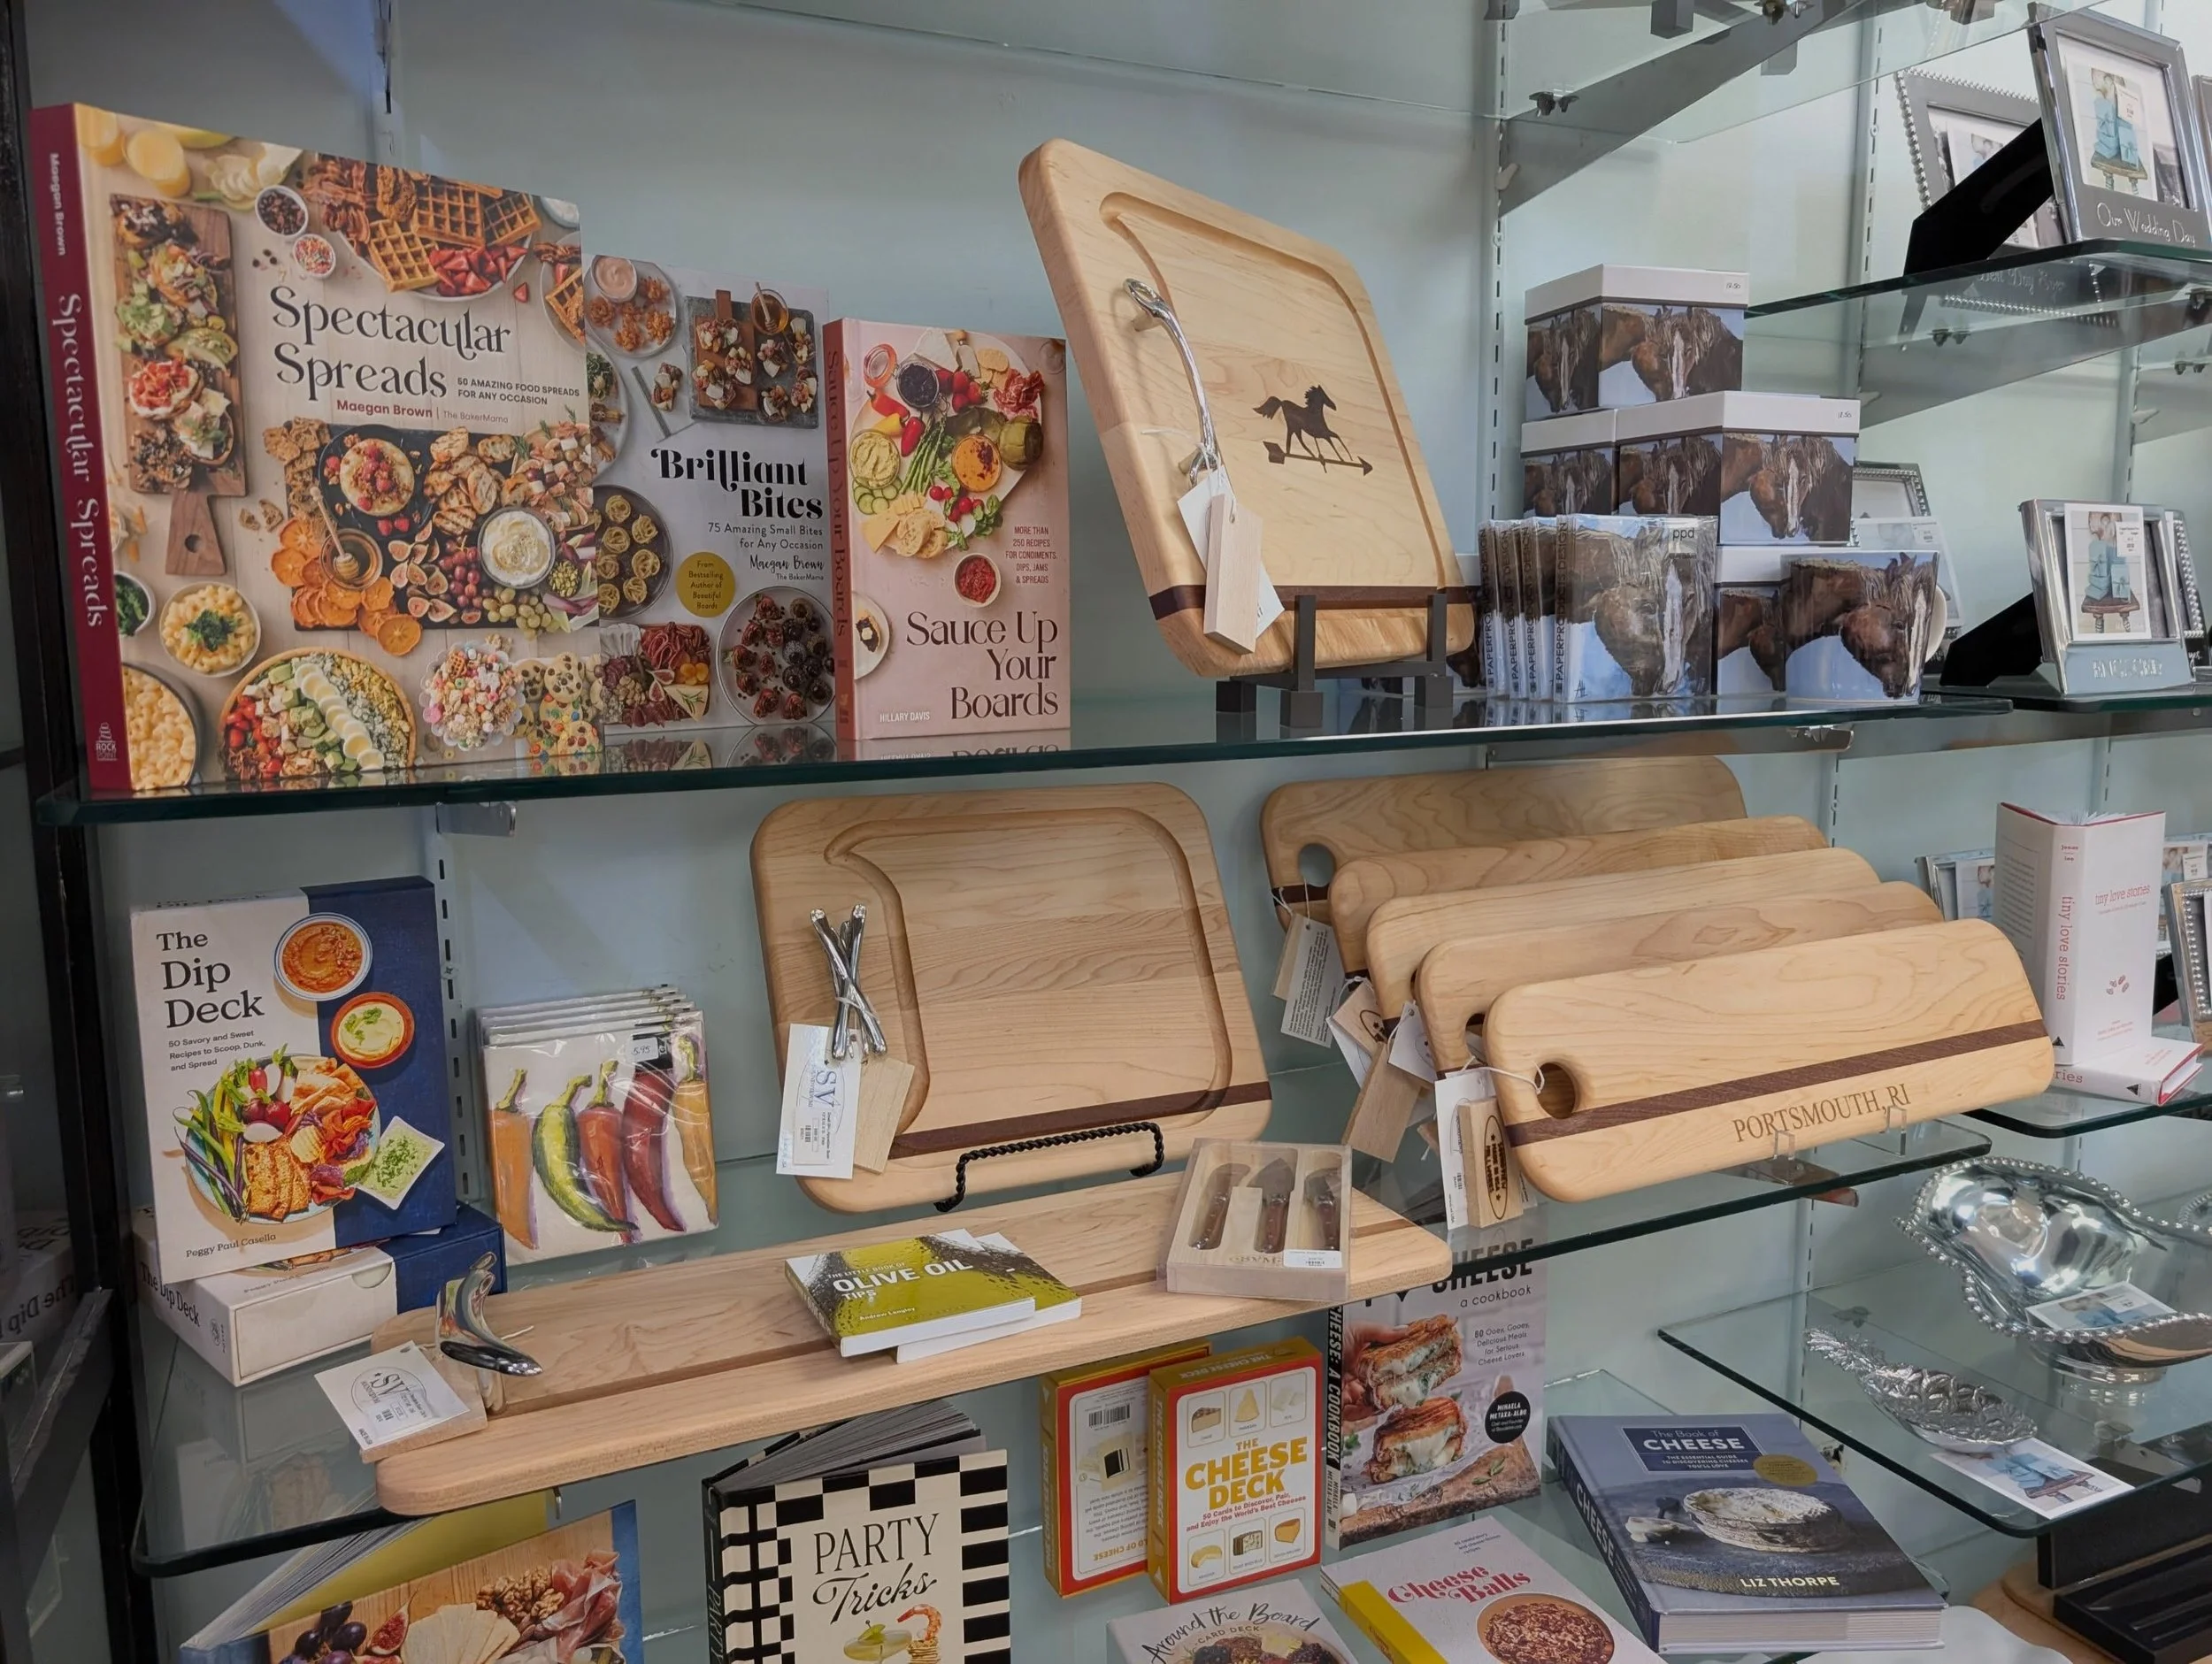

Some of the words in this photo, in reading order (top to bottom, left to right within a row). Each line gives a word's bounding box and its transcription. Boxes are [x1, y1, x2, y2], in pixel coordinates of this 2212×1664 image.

[54, 209, 65, 257] Brown
[2172, 219, 2196, 249] Day
[269, 286, 511, 361] Spectacular
[273, 341, 448, 402] Spreads
[457, 390, 476, 401] FOR
[479, 392, 497, 403] ANY
[499, 395, 549, 406] OCCASION
[472, 379, 513, 392] AMAZING
[516, 383, 541, 394] FOOD
[542, 386, 580, 397] SPREADS
[827, 350, 841, 431] Sauce
[336, 400, 389, 417] Maegan
[393, 404, 434, 419] Brown
[443, 410, 458, 421] The
[460, 411, 509, 424] BakerMama
[51, 292, 91, 482] Spectacular
[71, 497, 103, 628] Spreads
[650, 449, 808, 493] Brilliant
[740, 487, 824, 520] Bites
[708, 522, 721, 533] 75
[724, 523, 767, 538] Amazing
[770, 524, 796, 535] Small
[799, 526, 824, 536] Bites
[740, 538, 754, 548] for
[757, 539, 777, 552] Any
[780, 539, 824, 550] Occasion
[1672, 527, 1694, 541] ppd
[1556, 522, 1568, 571] DESIGN
[1016, 564, 1031, 572] DIPS,
[1022, 575, 1049, 584] SPREADS
[833, 546, 849, 637] Boards
[906, 611, 1007, 647] Sauce
[1017, 611, 1058, 654] Up
[1555, 575, 1566, 680] PAPERPRODUCTS
[987, 648, 1056, 680] Your
[951, 682, 1058, 720] Boards
[879, 713, 910, 723] HILLARY
[910, 711, 930, 721] DAVIS
[96, 742, 117, 751] ROCK
[2061, 896, 2074, 926] tiny
[157, 932, 208, 951] The
[2058, 926, 2072, 952] love
[162, 958, 231, 993] Dip
[2056, 955, 2070, 1001] stories
[165, 990, 265, 1029] Deck
[169, 1050, 201, 1061] Recipes
[213, 1044, 242, 1055] Scoop,
[243, 1041, 265, 1050] Dunk,
[182, 1037, 211, 1047] Savory
[212, 1032, 228, 1041] and
[230, 1030, 254, 1039] Sweet
[188, 1058, 218, 1069] Spread
[814, 1070, 837, 1108] SV
[1732, 1090, 1886, 1142] PORTSMOUTH,
[1886, 1084, 1910, 1108] RI
[186, 1246, 215, 1257] Peggy
[217, 1241, 240, 1251] Paul
[241, 1233, 276, 1246] Casella
[833, 1267, 921, 1293] OLIVE
[924, 1259, 972, 1277] OIL
[141, 1261, 158, 1292] The
[160, 1284, 175, 1309] Dip
[177, 1292, 200, 1327] Deck
[841, 1289, 877, 1300] TIPS
[1460, 1299, 1468, 1307] a
[1472, 1284, 1532, 1305] cookbook
[1477, 1336, 1507, 1347] Delicious
[1509, 1332, 1527, 1341] Meals
[1496, 1344, 1519, 1353] Serious
[1209, 1359, 1249, 1372] CHEESE
[1329, 1369, 1340, 1380] A
[1479, 1356, 1502, 1366] Cheese
[1504, 1352, 1525, 1361] Lovers
[374, 1373, 409, 1400] SV
[1326, 1385, 1341, 1464] COOKBOOK
[1236, 1438, 1258, 1450] THE
[1643, 1438, 1746, 1451] CHEESE
[1185, 1437, 1308, 1491] CHEESE
[1209, 1468, 1285, 1510] DECK
[1186, 1523, 1199, 1532] and
[1201, 1518, 1219, 1529] Enjoy
[1277, 1495, 1307, 1507] Cheeses
[1213, 1507, 1233, 1517] Cards
[1243, 1497, 1274, 1508] Discover,
[1576, 1486, 1617, 1566] CHEESE
[814, 1514, 940, 1575] PARTY
[812, 1562, 937, 1624] Tricks
[1388, 1566, 1489, 1603] Cheese
[1448, 1571, 1532, 1603] Balls
[1740, 1578, 1767, 1588] LIZ
[1770, 1577, 1839, 1587] THORPE
[709, 1585, 724, 1664] PARTY
[1142, 1613, 1206, 1664] Around
[1201, 1606, 1240, 1626] the
[1248, 1603, 1320, 1631] Board
[1198, 1629, 1225, 1644] CARD
